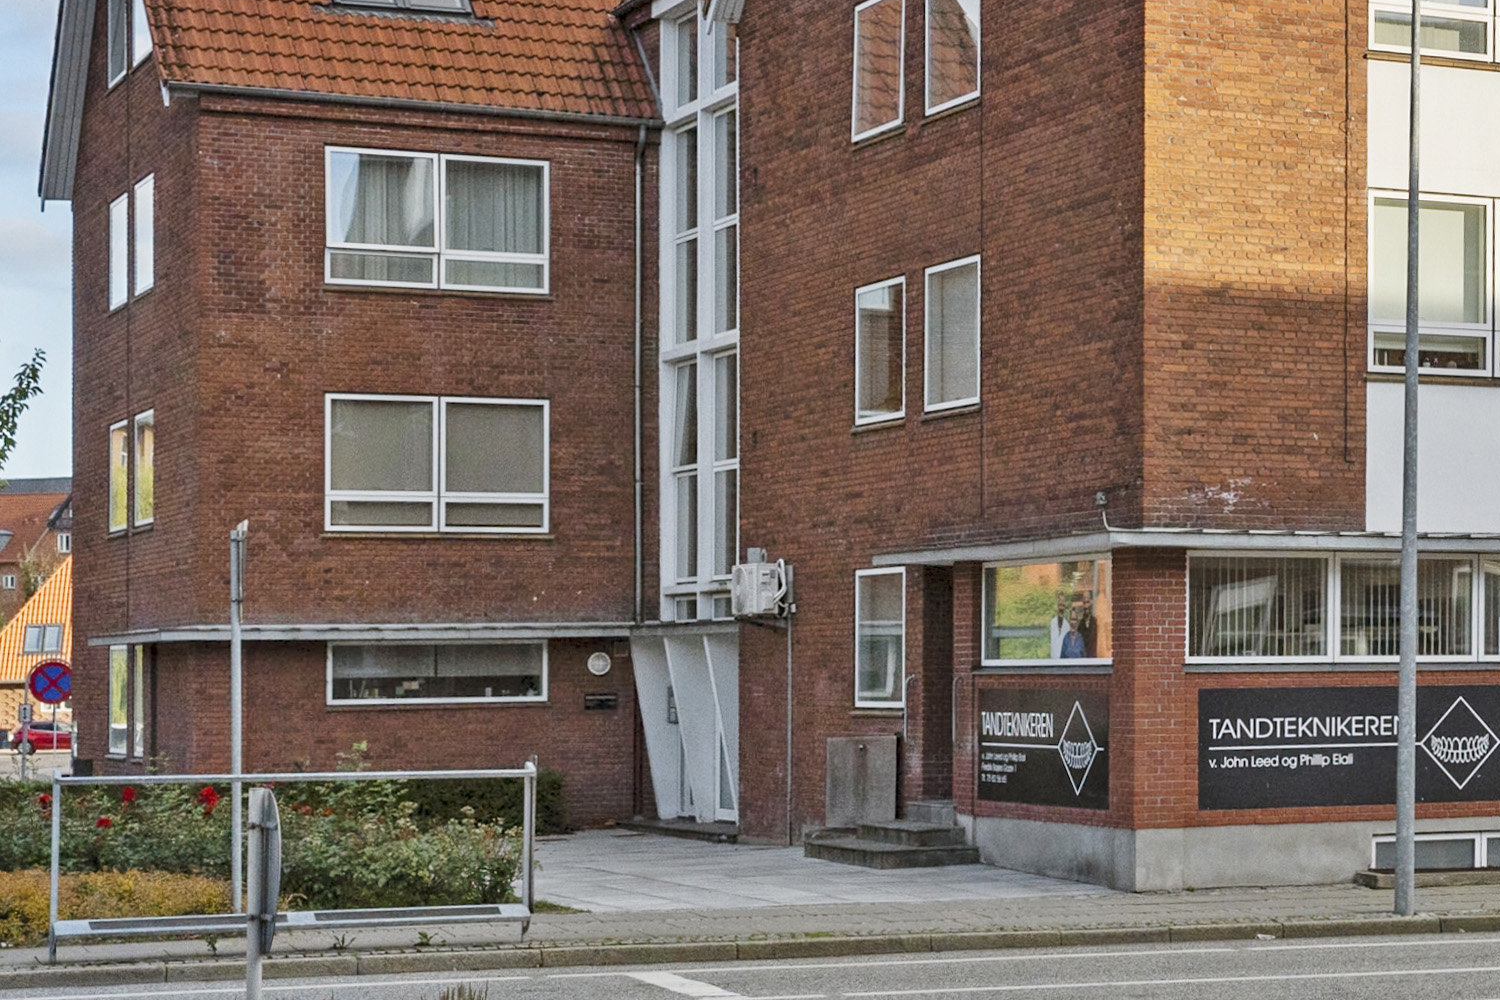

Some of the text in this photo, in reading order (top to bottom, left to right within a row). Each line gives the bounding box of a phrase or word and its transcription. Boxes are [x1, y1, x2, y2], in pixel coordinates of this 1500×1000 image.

[981, 711, 1054, 738] TANDTEKNIKEREN
[1208, 758, 1217, 769] v.
[1220, 756, 1249, 769] John
[1251, 755, 1279, 768] Leed
[1281, 756, 1298, 769] og
